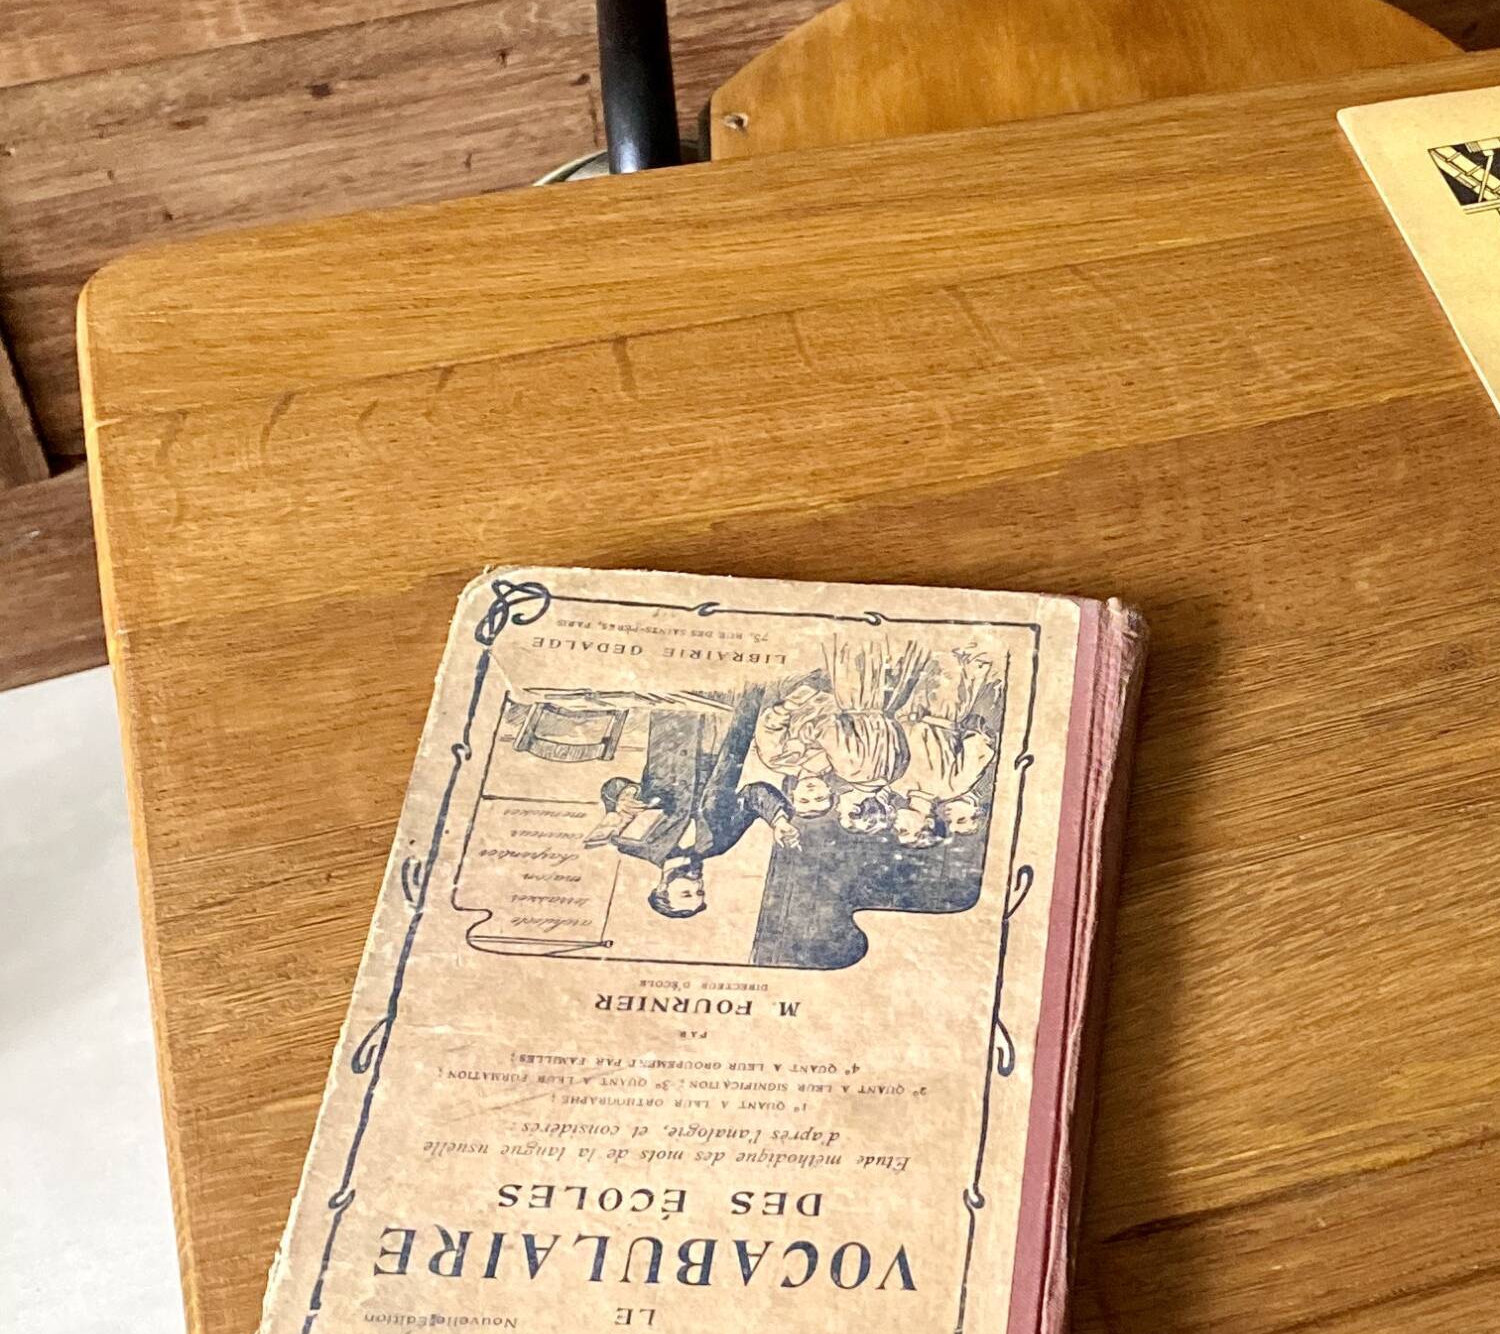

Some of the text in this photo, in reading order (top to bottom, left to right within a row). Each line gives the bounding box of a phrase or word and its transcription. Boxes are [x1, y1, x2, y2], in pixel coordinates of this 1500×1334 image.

[530, 635, 787, 666] LIBRAIRIE GEDALGE
[593, 991, 753, 1017] FOURNIER
[595, 1056, 623, 1068] PAR
[728, 1061, 765, 1073] LEUR
[789, 1062, 838, 1075] QUANT
[796, 1082, 833, 1095] LEUR
[857, 1083, 906, 1096] QUANT
[737, 1098, 786, 1111] QUANT
[632, 1125, 649, 1139] et
[772, 1126, 841, 1146] d'après
[423, 1140, 489, 1158] usuelle
[500, 1141, 566, 1161] langue
[578, 1145, 596, 1163] la
[606, 1147, 630, 1164] de
[639, 1147, 684, 1163] mots
[694, 1149, 726, 1166] des
[735, 1148, 843, 1168] méthodique
[495, 1182, 824, 1222] DES ÉCOLES
[372, 1223, 918, 1292] VOCABULAIRE
[614, 1306, 656, 1327] LE
